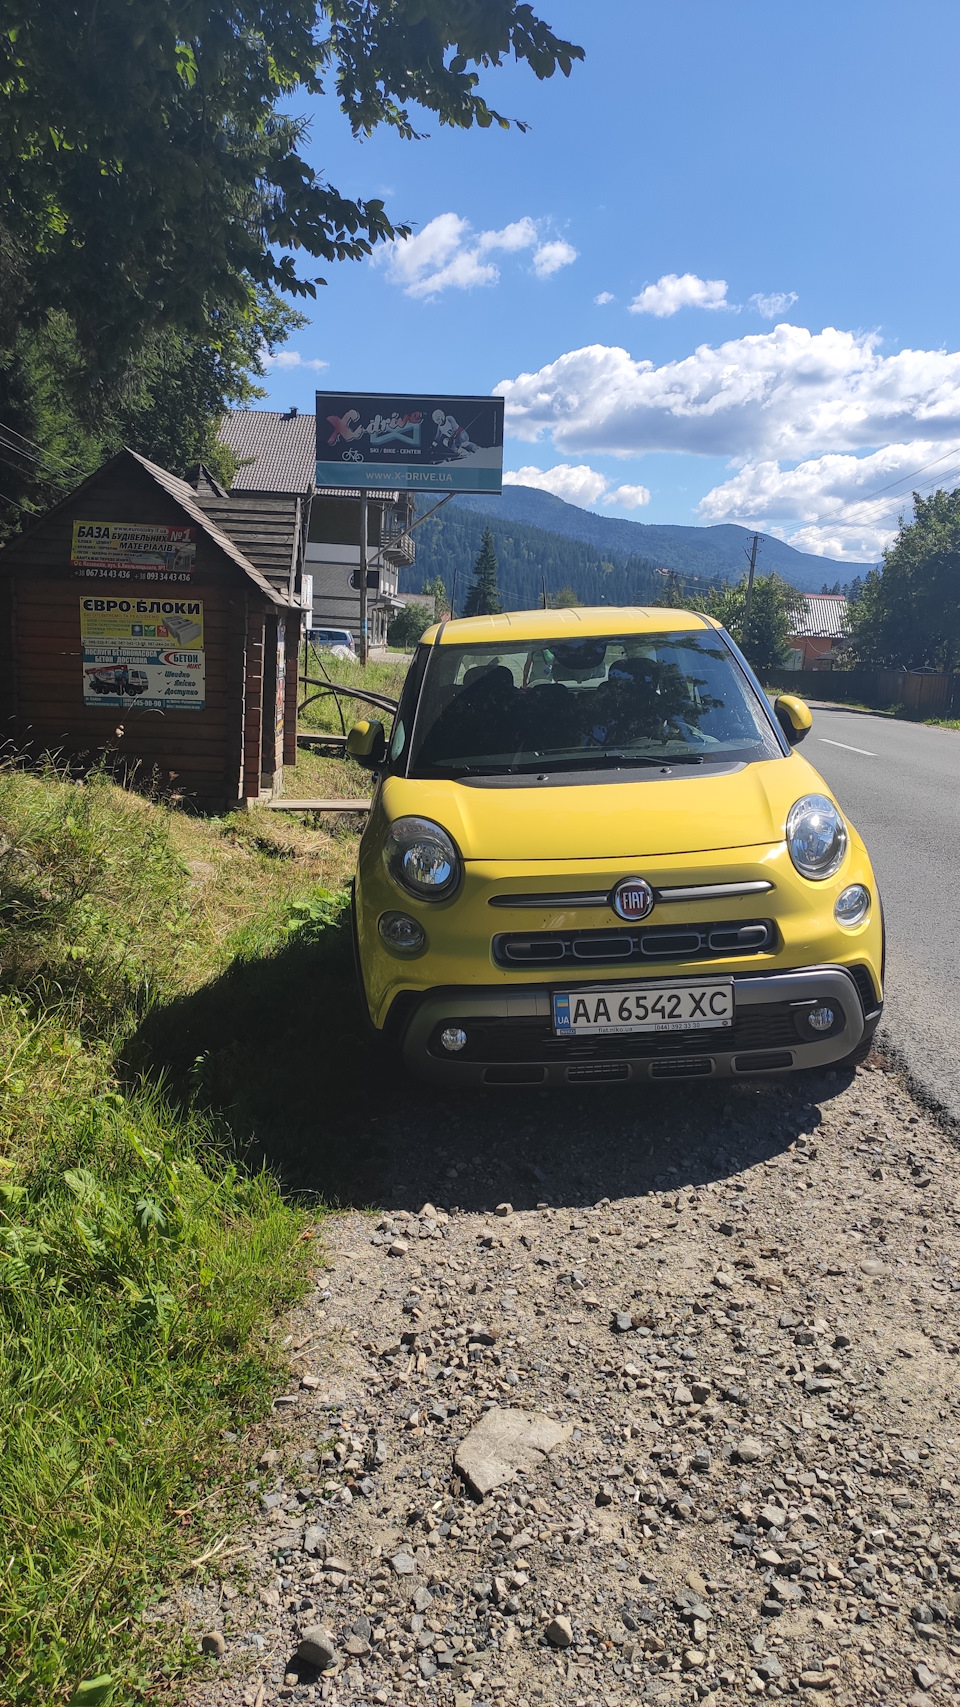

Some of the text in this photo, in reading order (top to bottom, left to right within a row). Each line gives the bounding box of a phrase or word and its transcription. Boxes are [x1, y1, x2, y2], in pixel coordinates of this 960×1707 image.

[366, 471, 453, 482] www.X-DRIVE.UA
[77, 526, 191, 542] БАЗА БУДІВЕЛЬНИХ №1
[119, 542, 173, 552] МАТЕРІАЛІВ
[86, 568, 99, 577] 067
[99, 569, 107, 577] 34
[108, 570, 117, 578] 43
[118, 570, 131, 578] 436
[146, 572, 159, 580] 093
[160, 573, 168, 581] 34
[169, 573, 177, 581] 43
[178, 574, 191, 582] 436
[173, 654, 198, 663] БЕТОН
[623, 891, 644, 909] FIAT
[573, 991, 728, 1024] AA 6542 XC
[558, 1016, 570, 1025] UA
